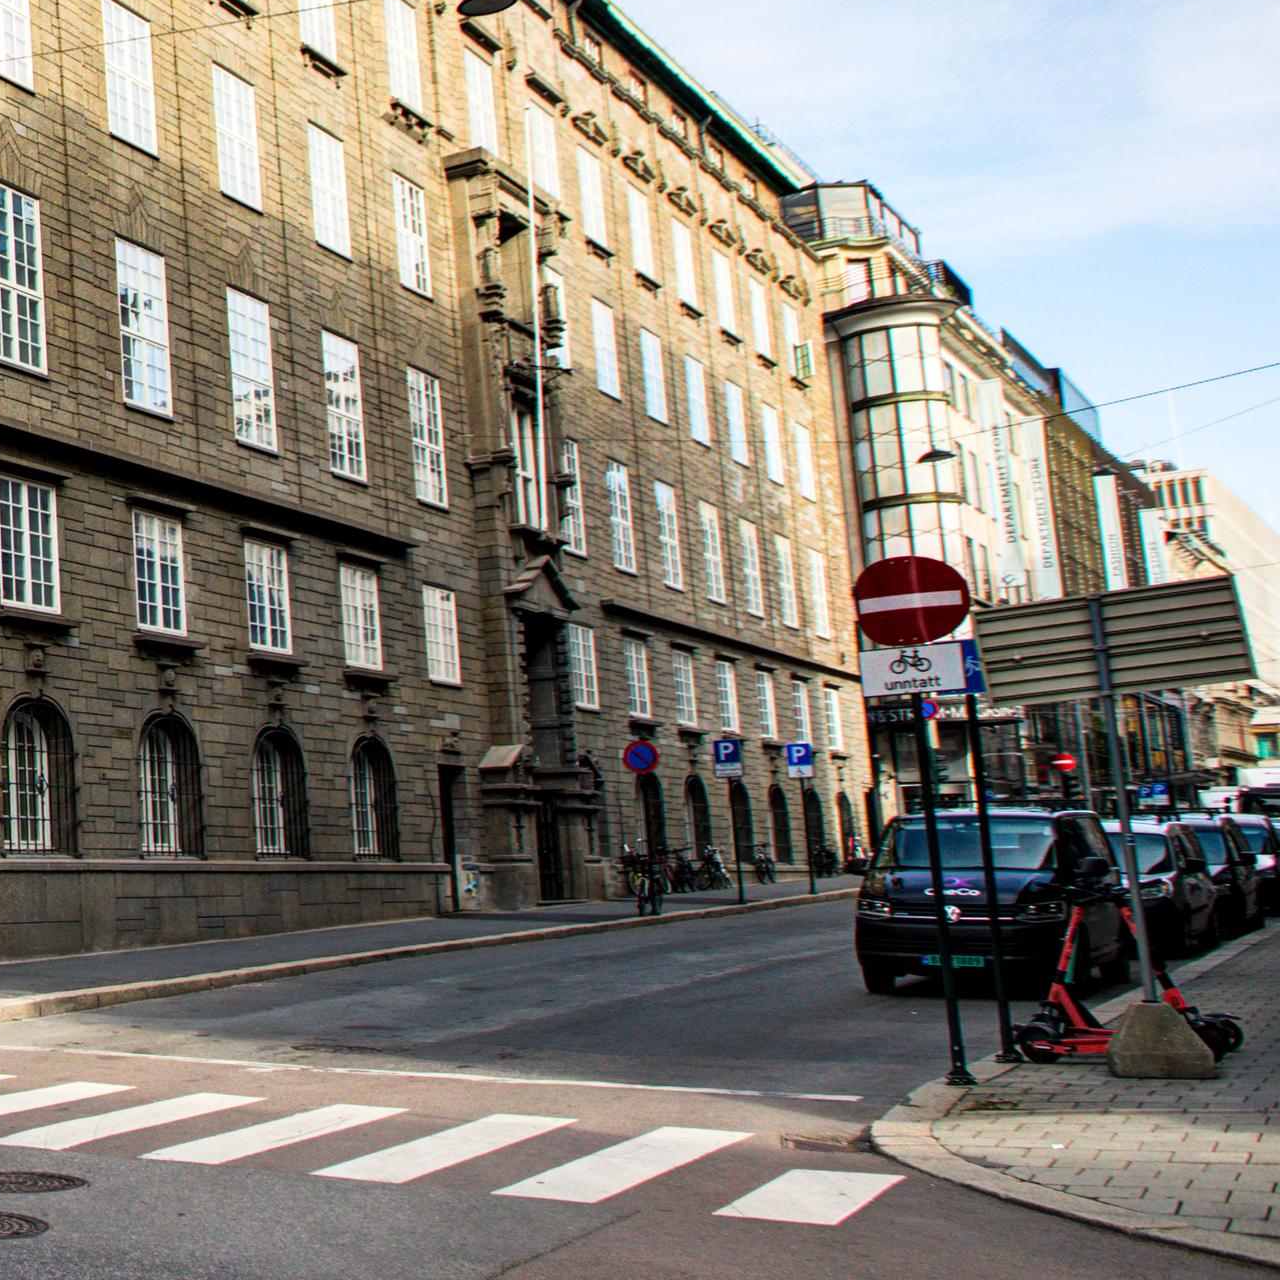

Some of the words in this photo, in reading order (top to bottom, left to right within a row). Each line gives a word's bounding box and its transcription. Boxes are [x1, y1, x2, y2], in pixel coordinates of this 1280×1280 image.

[1030, 458, 1042, 492] STORE
[997, 467, 1017, 544] DEPARTMENT
[1036, 496, 1053, 569] DEPARTMENT
[1108, 534, 1122, 577] FASHION
[884, 675, 942, 691] unntatt
[719, 742, 734, 761] P
[791, 746, 806, 763] P
